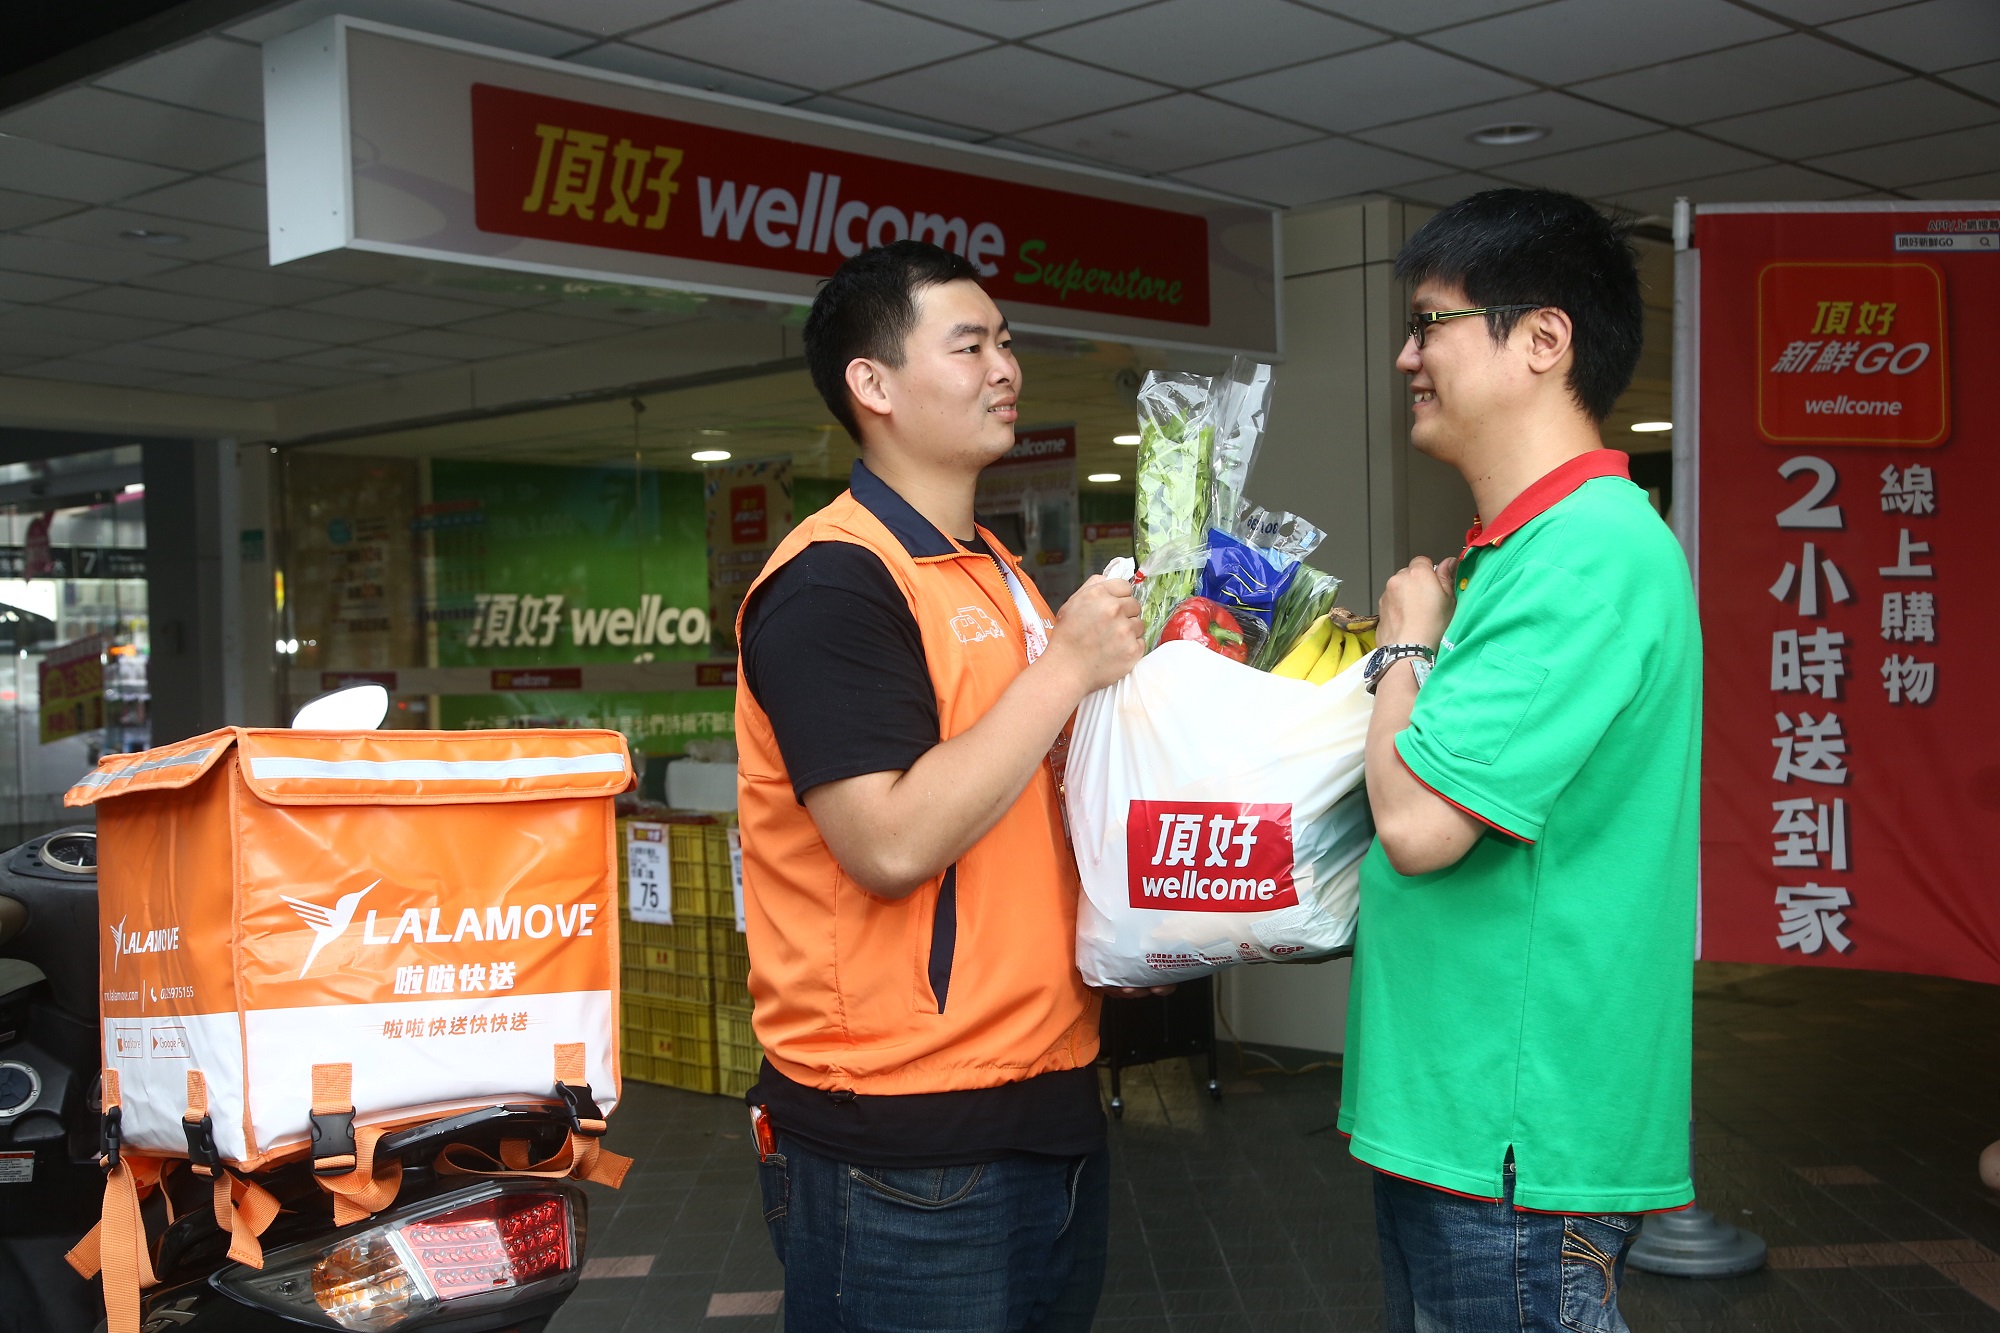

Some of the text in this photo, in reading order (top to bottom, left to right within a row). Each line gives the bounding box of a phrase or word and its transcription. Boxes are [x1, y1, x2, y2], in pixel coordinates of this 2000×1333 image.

[523, 123, 684, 231] 頂好
[697, 171, 1182, 305] wellcome Superstore
[1899, 236, 1954, 248] 頂好新鮮GO
[1810, 301, 1897, 336] 頂好
[1770, 340, 1931, 375] 新鮮GO
[1805, 396, 1902, 416] wellcome
[1878, 463, 1937, 705] 線上購物
[466, 593, 711, 647] 頂好 wellco
[1768, 455, 1853, 955] 2小時送到家
[1151, 813, 1260, 868] 頂好
[640, 882, 659, 908] 75
[1142, 870, 1277, 901] wellcome
[122, 926, 180, 955] LALAMOVE
[362, 902, 597, 945] LALAMOVE
[393, 961, 517, 995] 啦啦快送
[383, 1011, 528, 1040] 啦啦快送快快送
